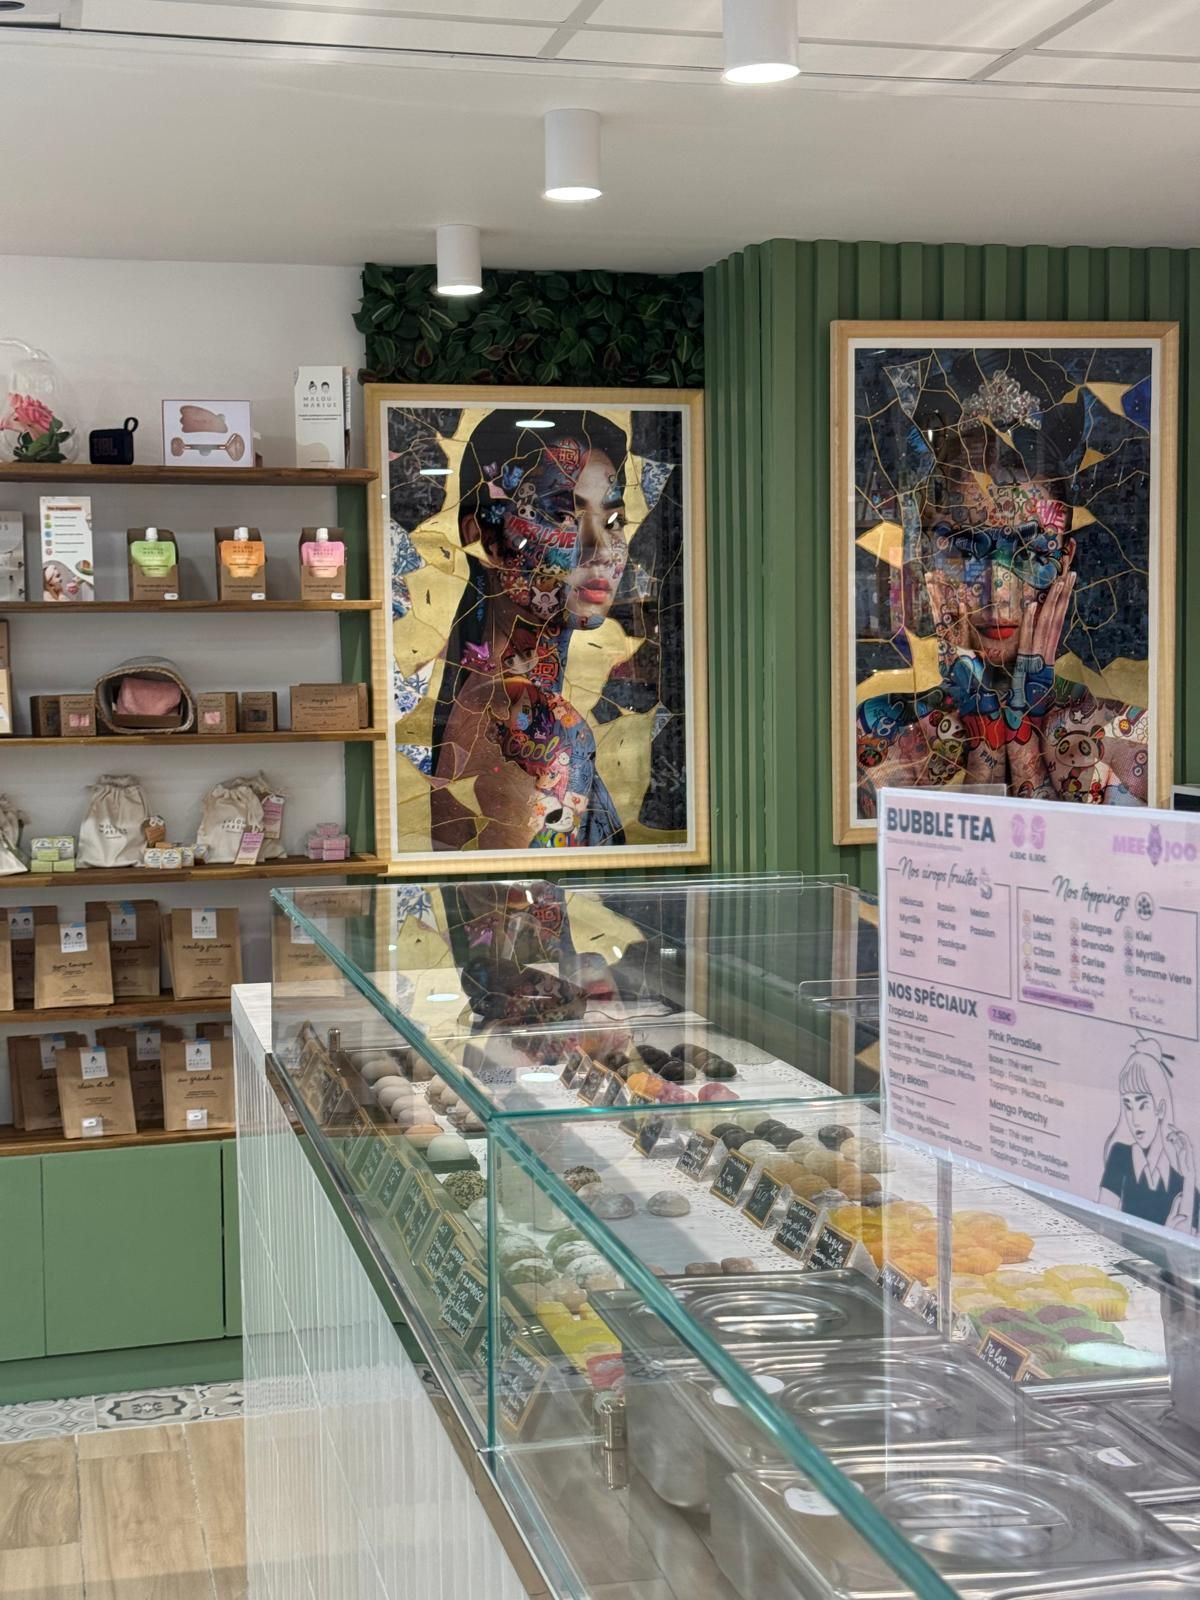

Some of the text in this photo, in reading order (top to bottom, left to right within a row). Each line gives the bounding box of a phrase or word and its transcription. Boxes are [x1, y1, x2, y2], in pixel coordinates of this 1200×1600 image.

[540, 526, 578, 549] LOVE
[506, 735, 561, 762] Cool
[887, 807, 996, 843] BUBBLE TEA
[1112, 835, 1197, 862] MEE JOO
[898, 856, 978, 891] Nos sirops fruités
[1052, 875, 1131, 922] Nos toppings
[1081, 922, 1113, 937] Mangue
[1136, 930, 1153, 942] Kiwi
[1081, 939, 1115, 953] Grenade
[1136, 948, 1166, 963] Myrtille
[1081, 971, 1105, 985] Pêche
[1136, 966, 1167, 981] Pomme
[1169, 971, 1192, 985] Verte
[887, 980, 979, 1018] NOS SPÉCIAUX
[888, 1004, 915, 1019] Tropical
[988, 1028, 1043, 1052] Pink Paradise
[907, 1073, 929, 1089] Bloom
[989, 1097, 1048, 1129] Mango Peachy
